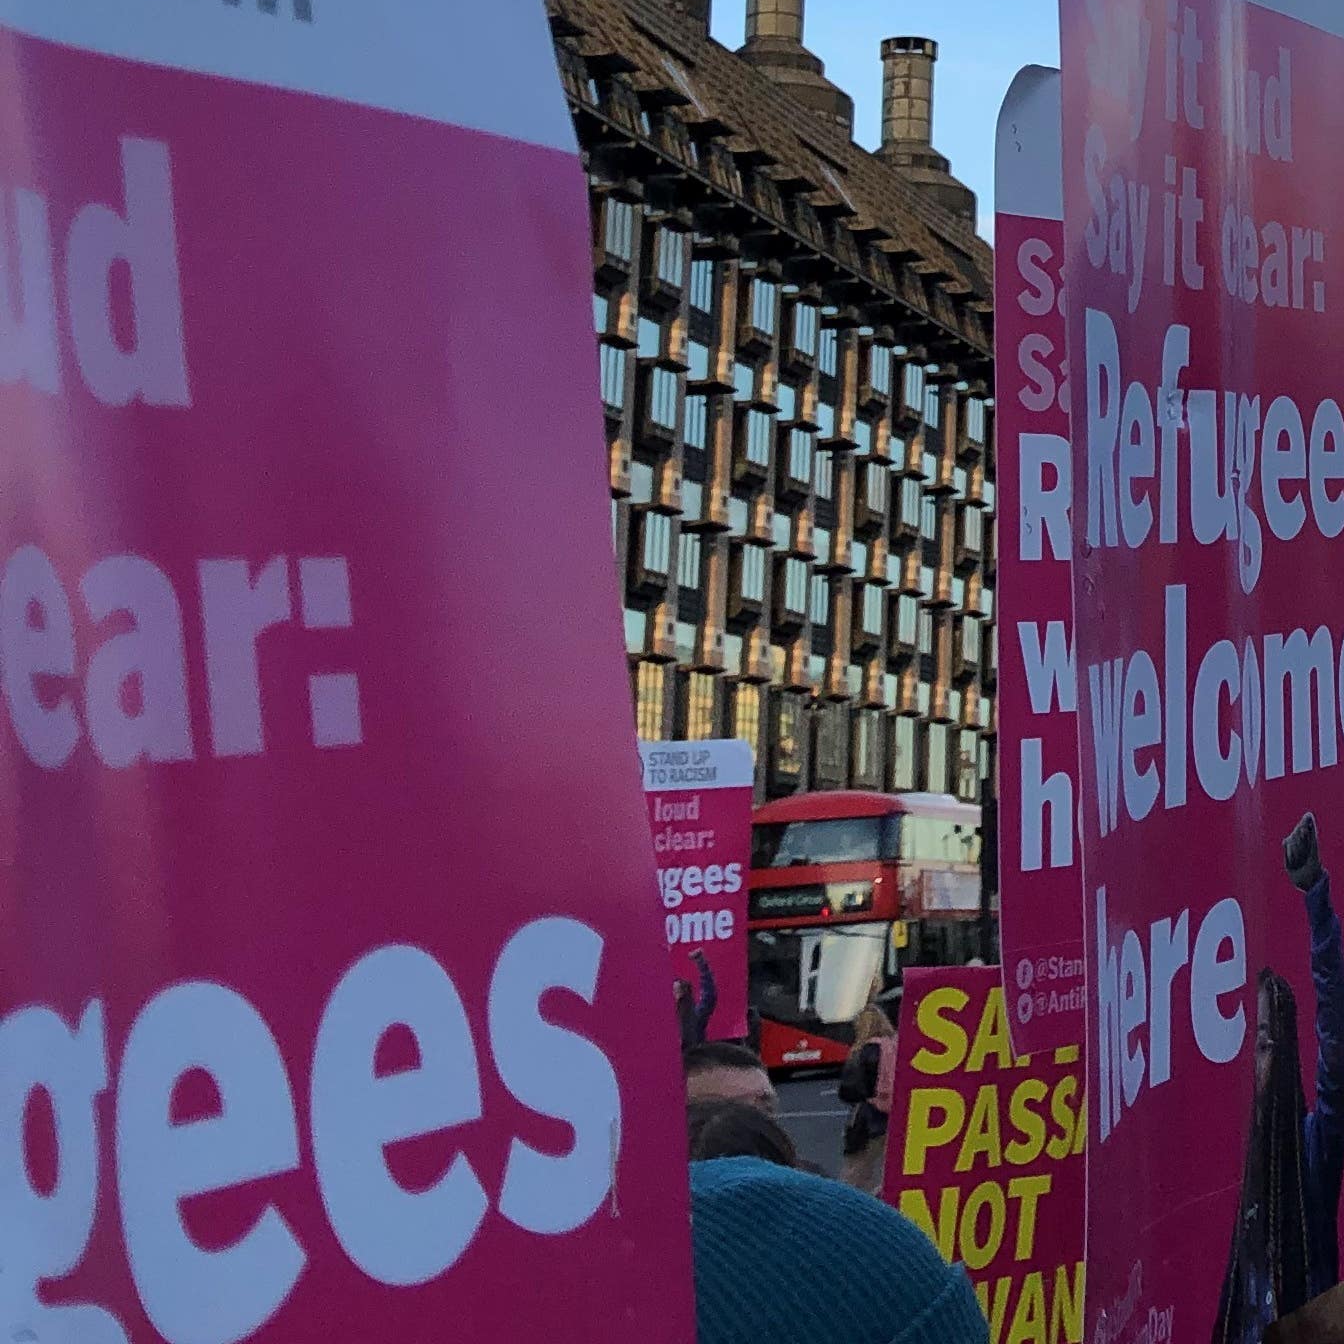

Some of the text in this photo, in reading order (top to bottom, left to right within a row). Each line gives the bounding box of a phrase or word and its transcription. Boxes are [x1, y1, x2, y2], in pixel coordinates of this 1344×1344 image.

[1085, 122, 1149, 314] Say
[1162, 156, 1204, 291] it
[648, 750, 711, 767] STAND UP
[650, 766, 717, 785] TO RACISM
[654, 795, 700, 822] loud
[654, 826, 716, 852] clear:
[1096, 885, 1248, 1145] here
[899, 1174, 1053, 1271] NOT
